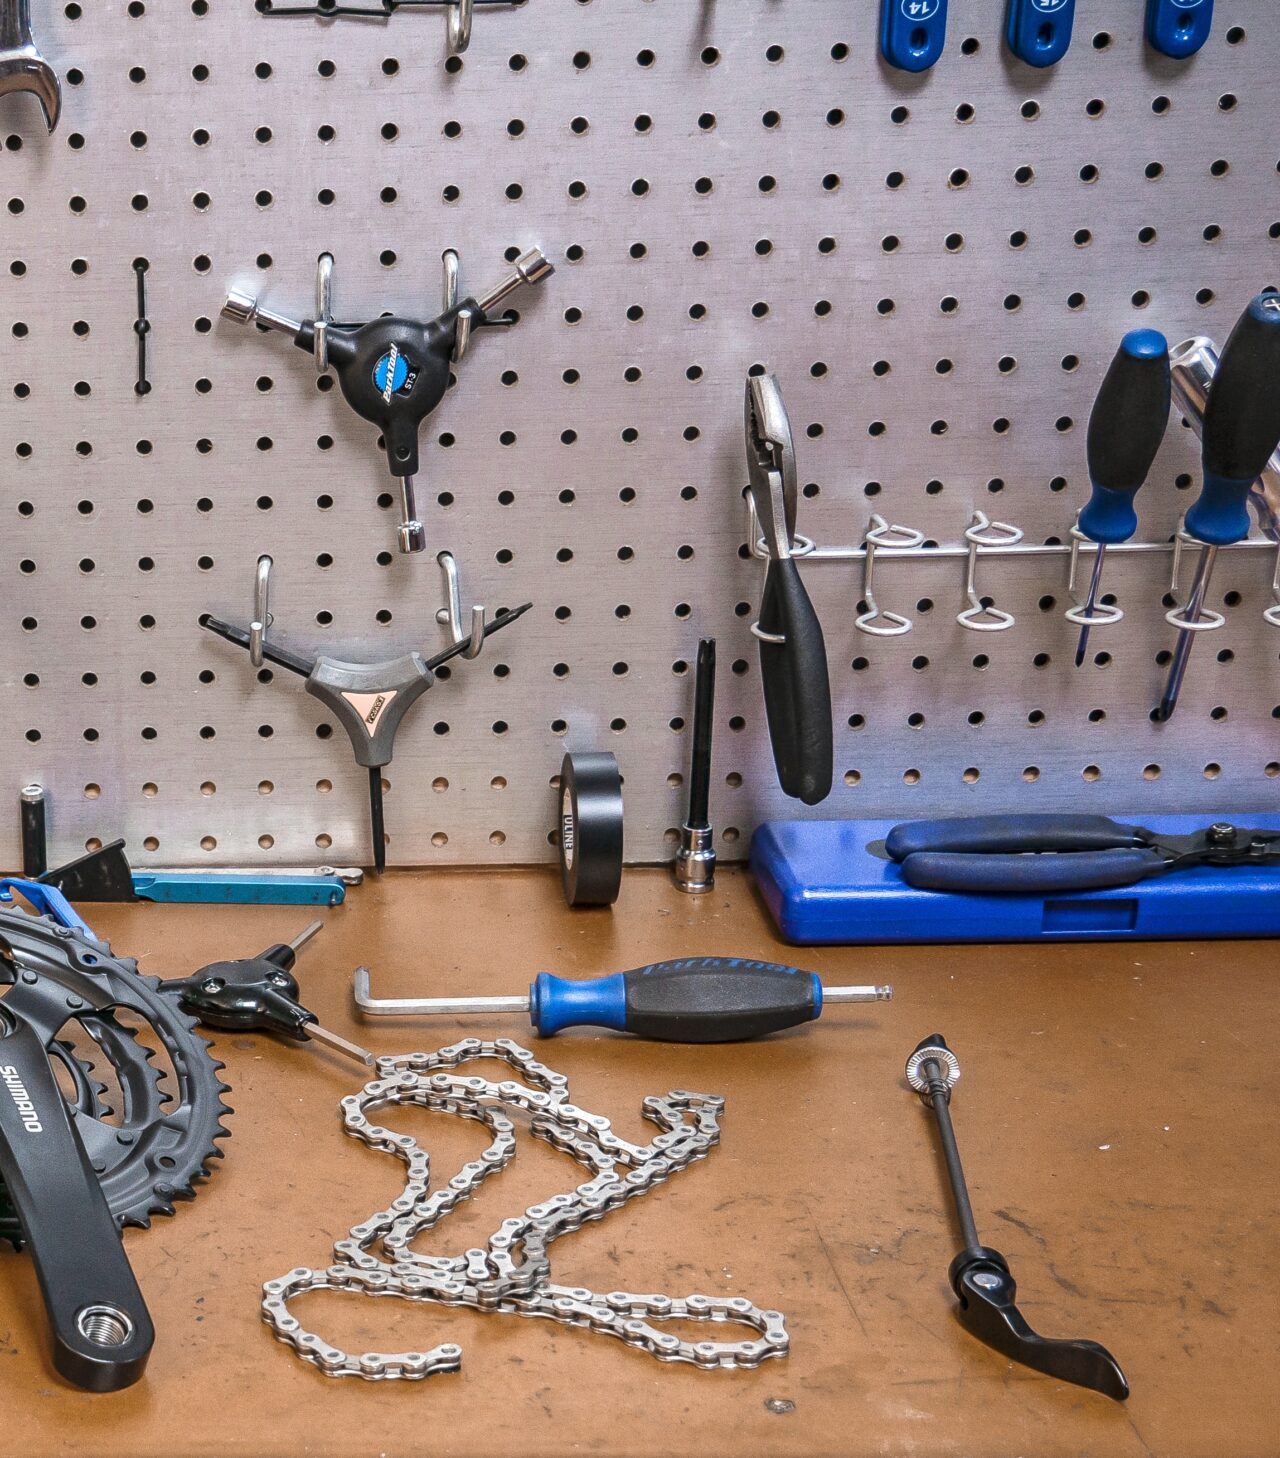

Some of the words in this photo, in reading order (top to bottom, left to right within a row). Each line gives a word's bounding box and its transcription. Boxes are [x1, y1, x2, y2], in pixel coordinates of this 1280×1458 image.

[909, 1, 929, 14] 14
[405, 373, 416, 389] ST-3
[563, 816, 574, 850] ULINE
